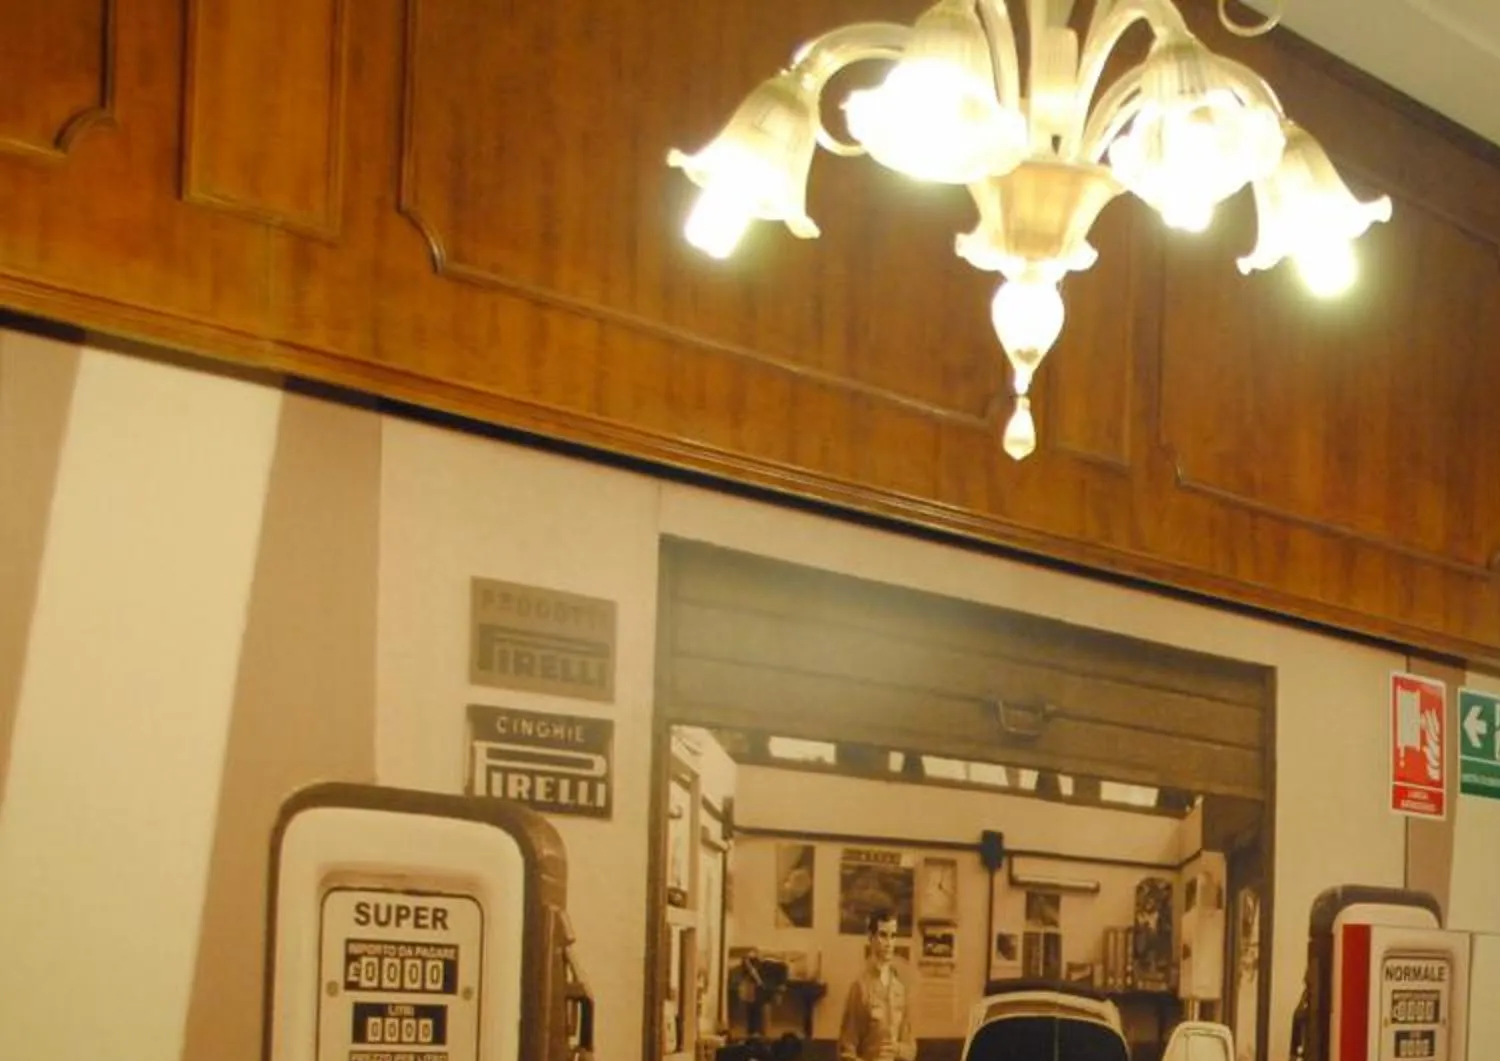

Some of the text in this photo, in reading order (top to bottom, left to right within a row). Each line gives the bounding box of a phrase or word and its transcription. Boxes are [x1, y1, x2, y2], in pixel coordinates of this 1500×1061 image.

[496, 716, 585, 742] CINGHIE
[472, 740, 608, 807] PIRELLI
[354, 901, 449, 931] SUPER
[1384, 964, 1446, 983] NORMALE
